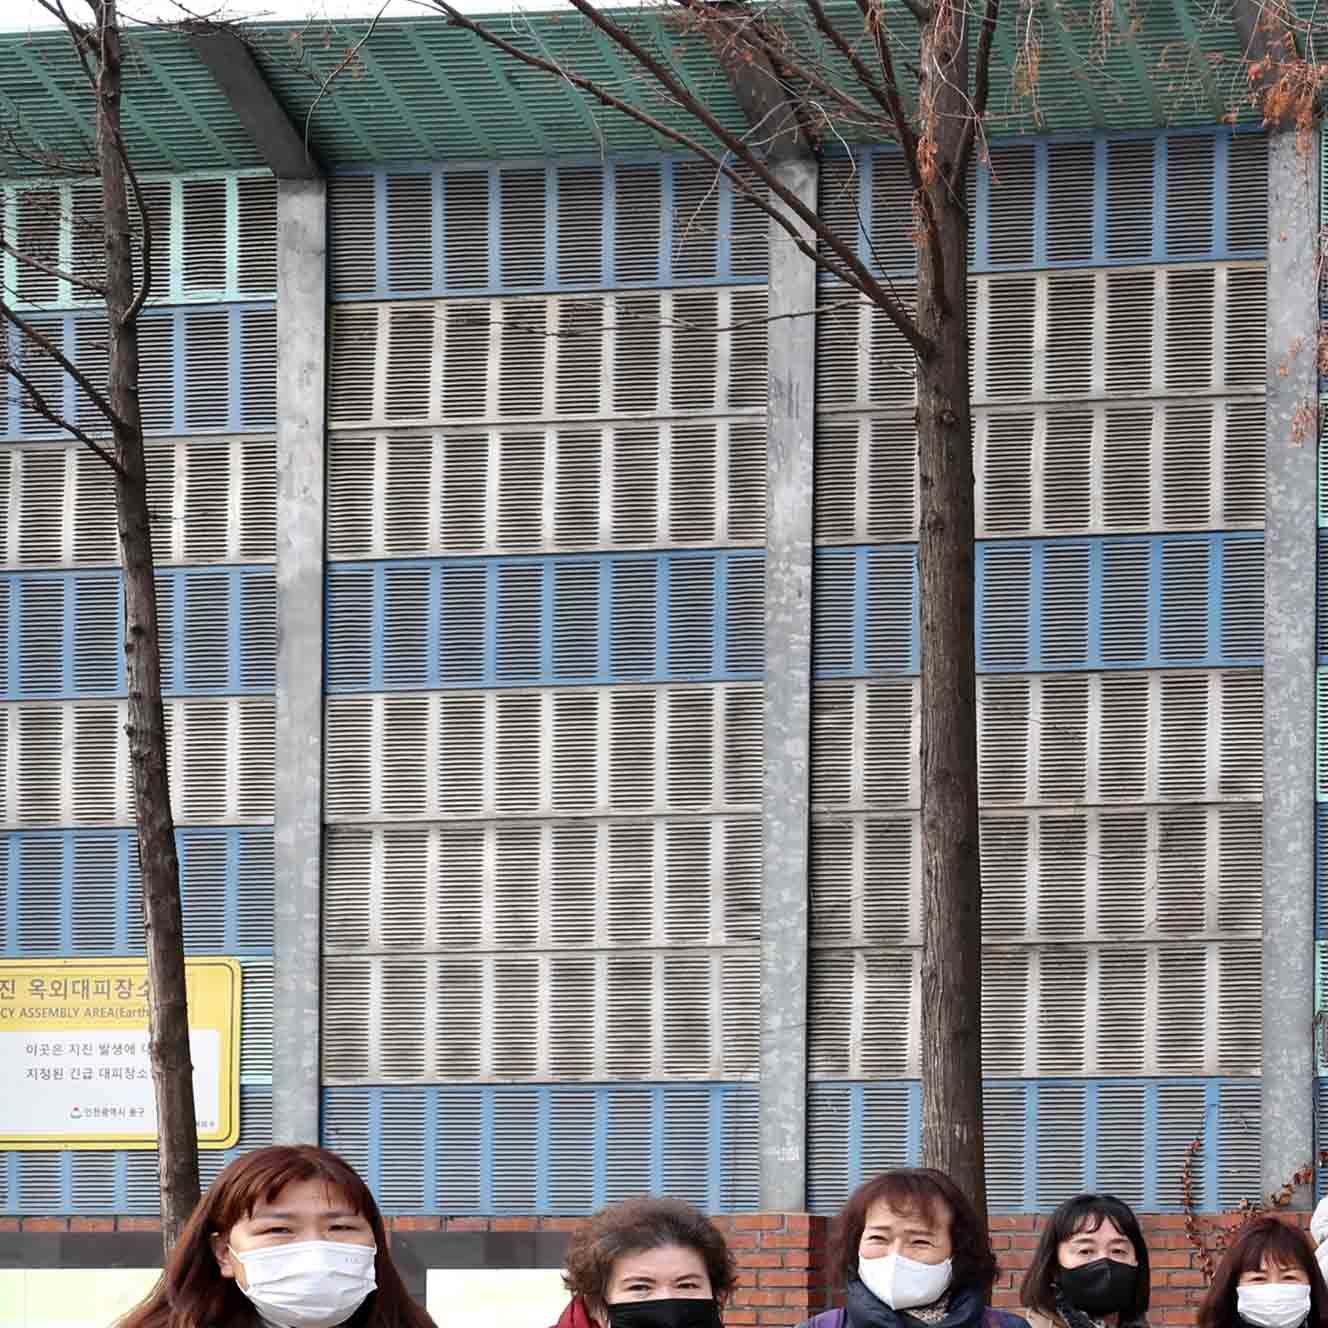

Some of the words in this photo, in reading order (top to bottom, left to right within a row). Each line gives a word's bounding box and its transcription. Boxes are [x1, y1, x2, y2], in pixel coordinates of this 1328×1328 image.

[28, 979, 150, 1000] 옥외대피장소
[21, 1007, 80, 1018] ASSEMBLY
[26, 1043, 65, 1057] 이곳은
[69, 1043, 94, 1057] 지진
[99, 1043, 137, 1057] 발생에
[26, 1067, 65, 1081] 지정된
[70, 1067, 94, 1081] 긴급
[99, 1067, 149, 1081] 대피장소
